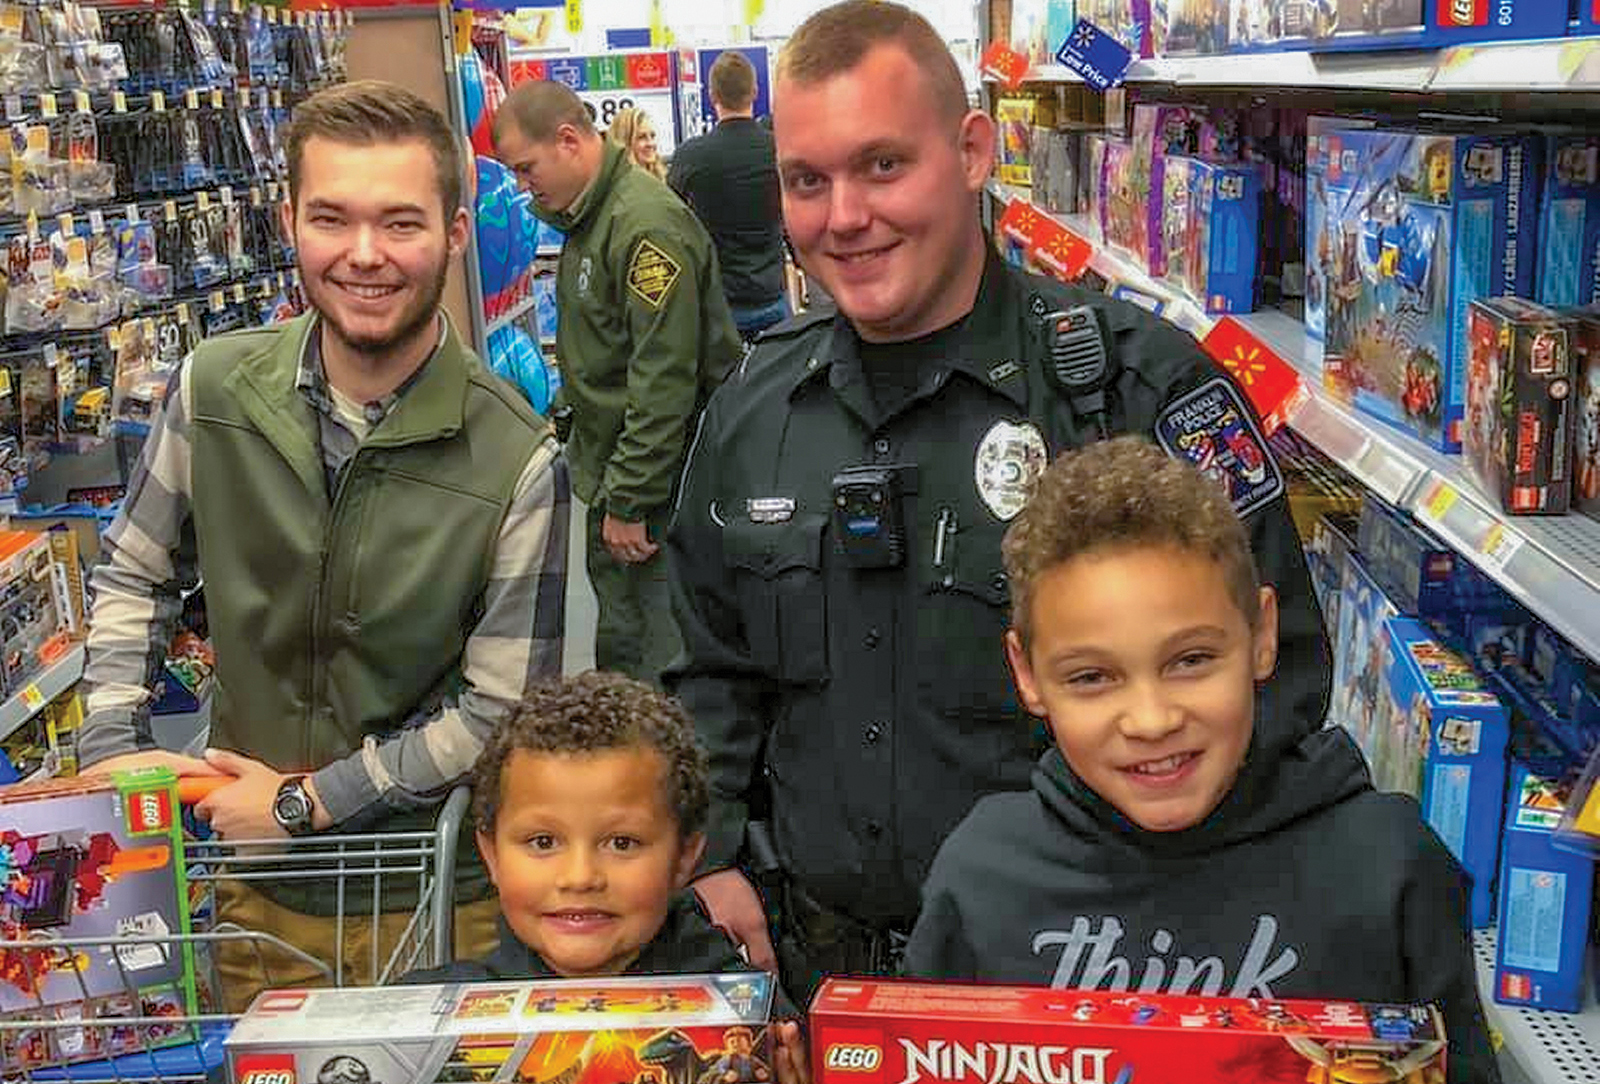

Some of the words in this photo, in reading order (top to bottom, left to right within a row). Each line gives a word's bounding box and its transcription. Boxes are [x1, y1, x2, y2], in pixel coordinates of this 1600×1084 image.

[1059, 50, 1083, 70] Low
[1081, 63, 1109, 87] Price
[159, 323, 180, 351] 50
[1183, 405, 1225, 433] POLICE
[142, 795, 159, 827] LEGO
[1032, 915, 1299, 999] Think
[828, 1047, 880, 1069] LEGO
[897, 1038, 1118, 1084] NINJAGO
